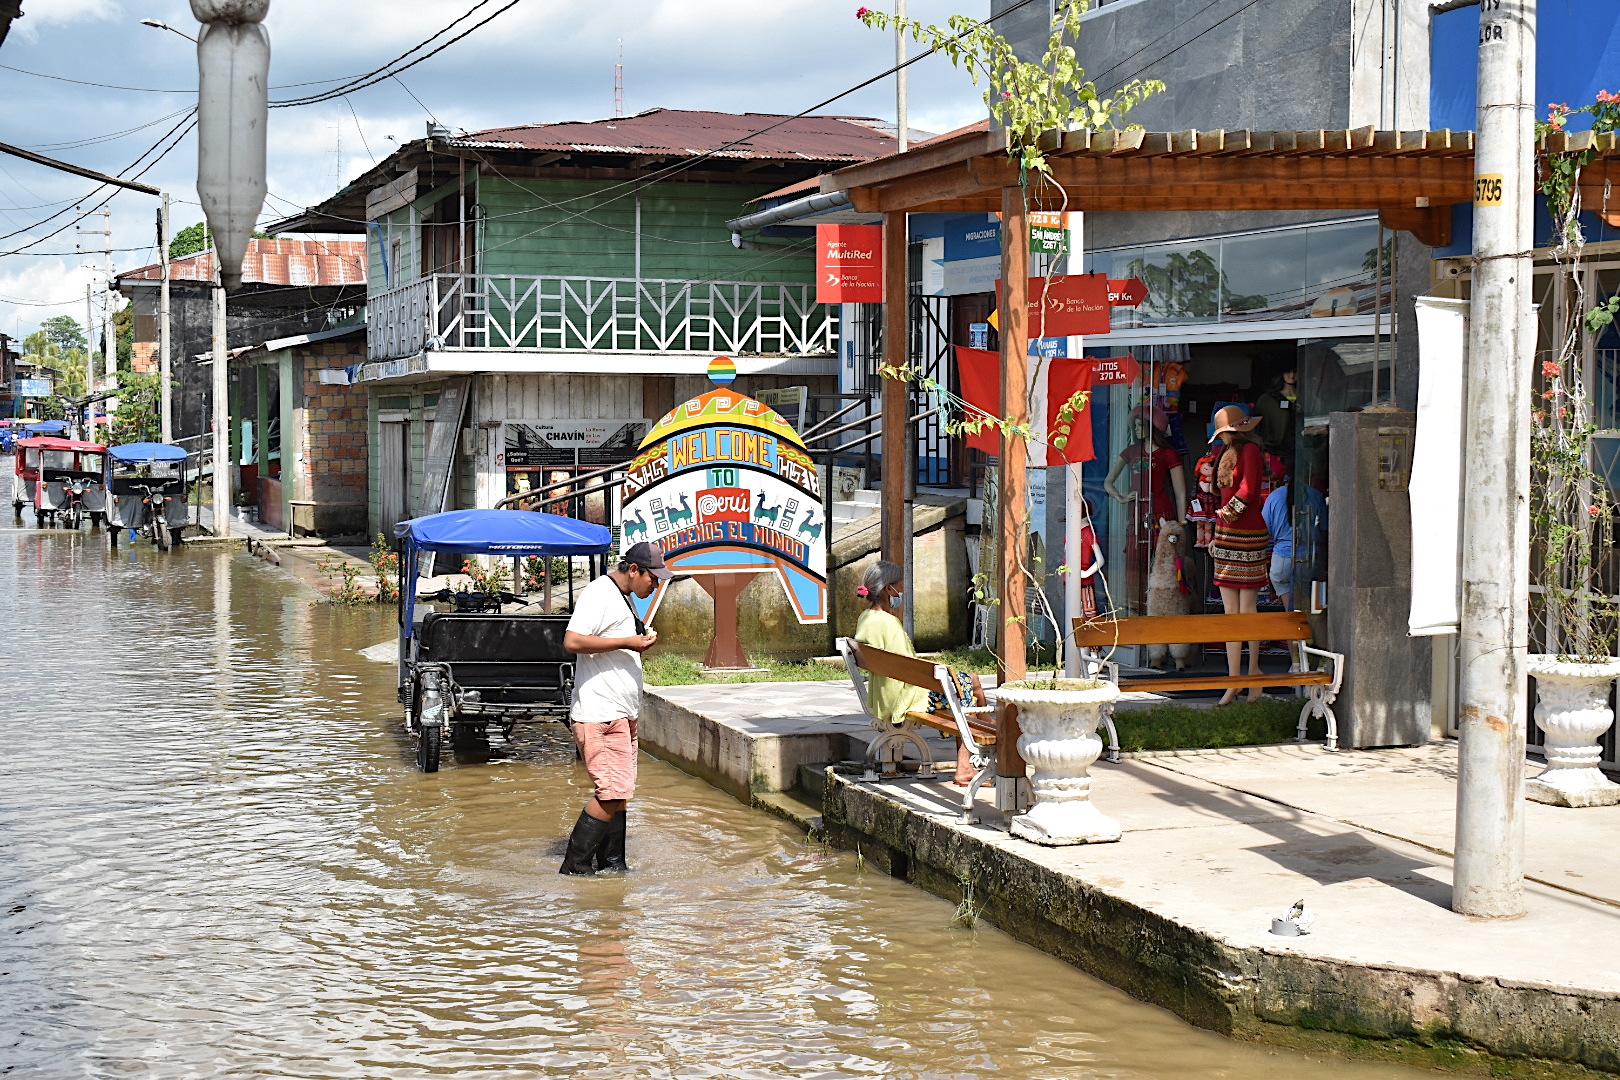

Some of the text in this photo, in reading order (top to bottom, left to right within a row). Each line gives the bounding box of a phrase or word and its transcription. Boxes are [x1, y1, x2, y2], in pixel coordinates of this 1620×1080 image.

[1475, 179, 1501, 201] 5795
[965, 229, 996, 241] MIGRACIONES
[1043, 230, 1064, 241] ANDRÉ
[827, 241, 847, 249] Agente
[827, 250, 872, 259] MultiRed
[1108, 293, 1119, 302] 64
[1066, 304, 1104, 313] de la Nación
[1099, 372, 1114, 381] 370
[546, 430, 585, 441] CHAVÍN
[672, 429, 773, 470] WELCOME
[711, 469, 735, 486] TO
[699, 493, 750, 523] Perú
[655, 521, 806, 562] MBIEMOS EL MUNDO
